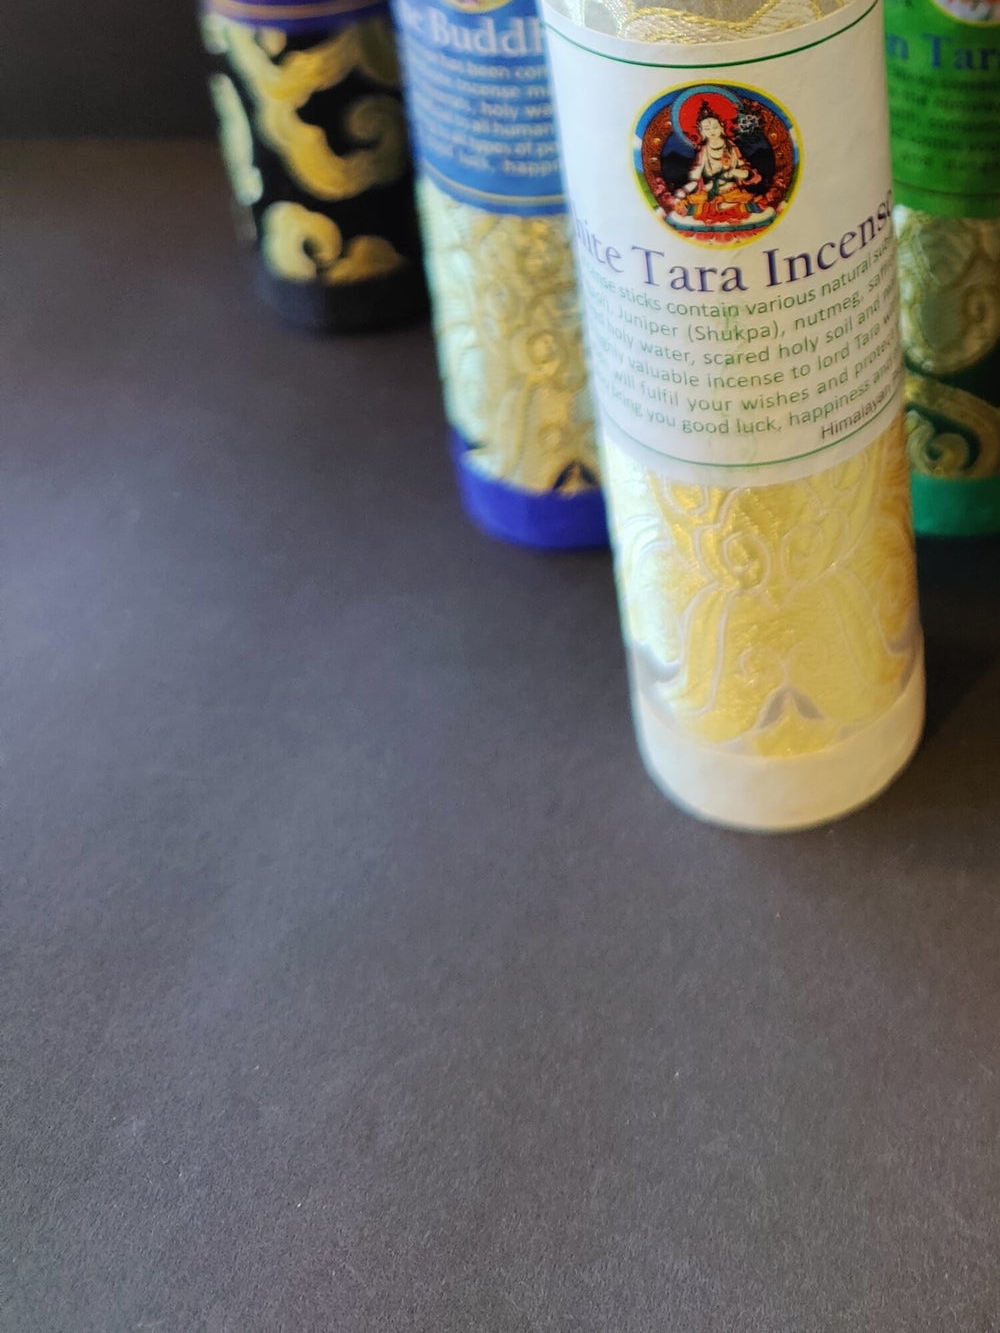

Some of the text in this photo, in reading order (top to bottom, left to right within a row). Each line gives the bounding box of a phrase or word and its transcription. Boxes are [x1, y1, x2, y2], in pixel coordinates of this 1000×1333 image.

[618, 285, 662, 311] sticks
[667, 302, 740, 318] contain
[745, 288, 816, 316] various
[821, 252, 871, 297] natural
[631, 244, 749, 293] Tara
[607, 320, 634, 349] holy
[640, 340, 696, 366] water,
[703, 346, 770, 365] scared
[778, 335, 819, 360] holy
[825, 318, 853, 344] soil
[857, 296, 880, 325] and
[618, 305, 678, 337] Juniper
[688, 320, 786, 343] (Shukpa),
[794, 291, 865, 331] nutmeg,
[628, 355, 700, 388] valuable
[707, 371, 785, 388] incense
[791, 363, 811, 380] to
[817, 343, 850, 371] lord
[854, 323, 881, 350] Tara
[613, 369, 635, 389] will
[640, 380, 679, 407] fulfil
[687, 397, 732, 412] your
[741, 387, 810, 411] wishes
[816, 368, 848, 394] and
[646, 408, 676, 427] you
[682, 419, 729, 434] good
[736, 416, 782, 434] luck,
[789, 379, 870, 426] happiness
[821, 382, 892, 439] Himalayan
